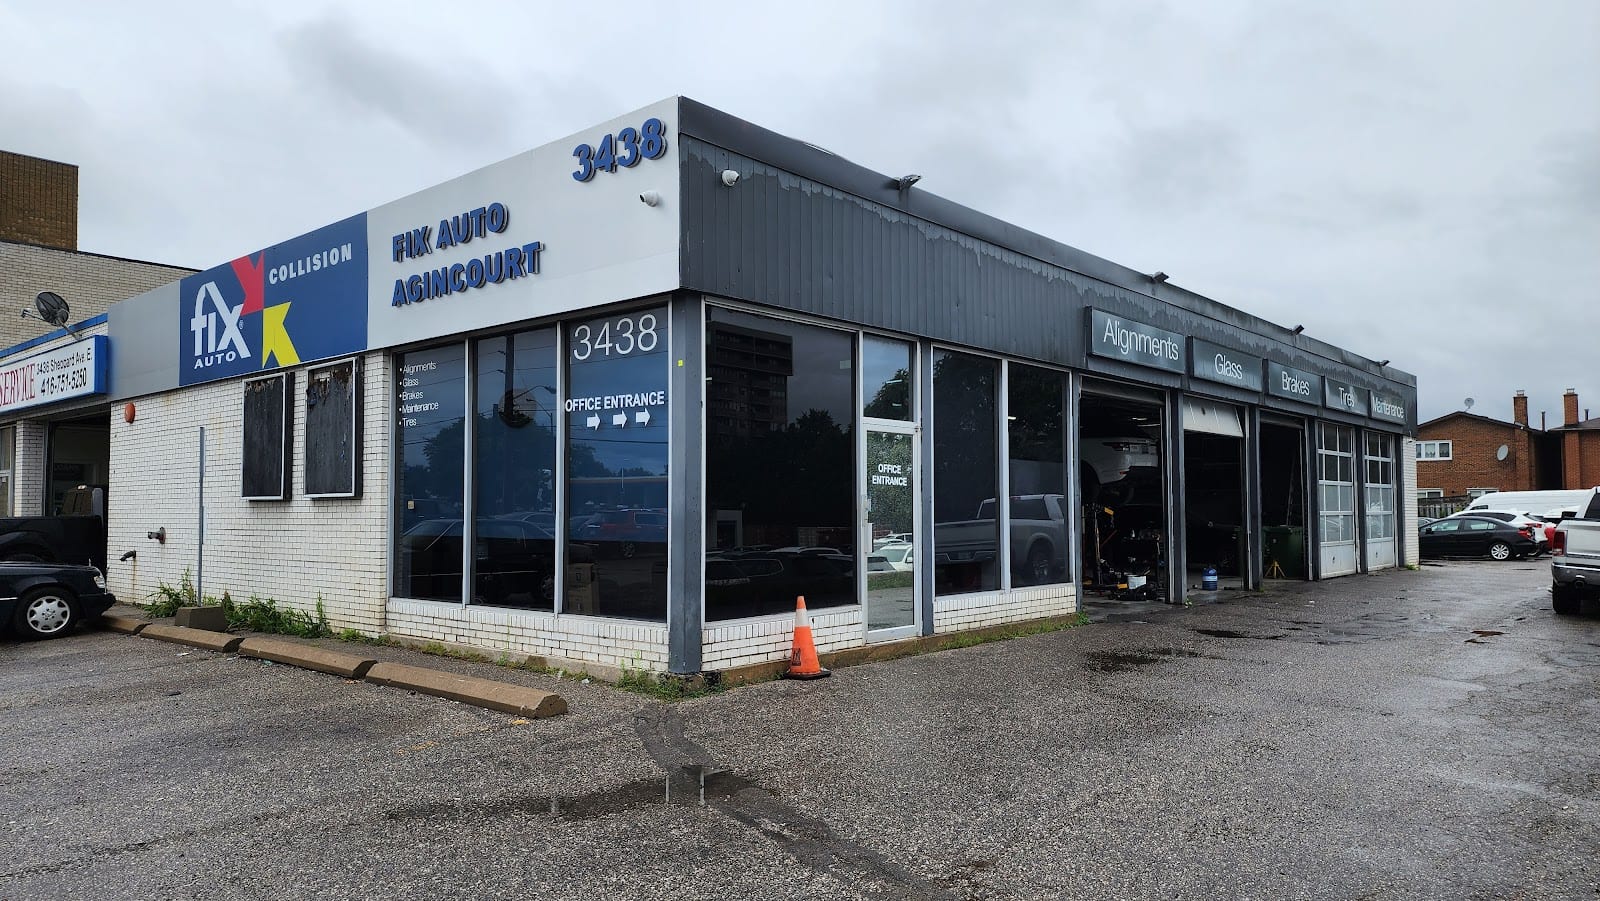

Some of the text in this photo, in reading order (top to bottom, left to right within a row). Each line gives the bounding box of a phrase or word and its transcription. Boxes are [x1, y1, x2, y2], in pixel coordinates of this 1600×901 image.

[572, 118, 667, 182] 3438
[392, 202, 509, 262] FIX AUTO
[269, 243, 352, 285] COLLISION
[391, 241, 545, 307] AGINCOURT
[573, 313, 658, 360] 3438
[1103, 318, 1179, 361] Alignments
[194, 350, 236, 370] AUTO
[402, 361, 437, 375] Alignments
[1214, 353, 1242, 380] Glass
[402, 378, 419, 387] Glass
[1281, 371, 1310, 396] Brakes
[402, 391, 424, 401] Brakes
[565, 391, 665, 412] OFFICE ENTRANCE
[1338, 387, 1355, 408] Tires
[402, 402, 439, 414] Maintenance
[1371, 395, 1405, 419] Maintenance
[402, 417, 417, 428] Tires
[878, 463, 902, 474] OFFICE
[872, 475, 908, 486] ENTRANCE
